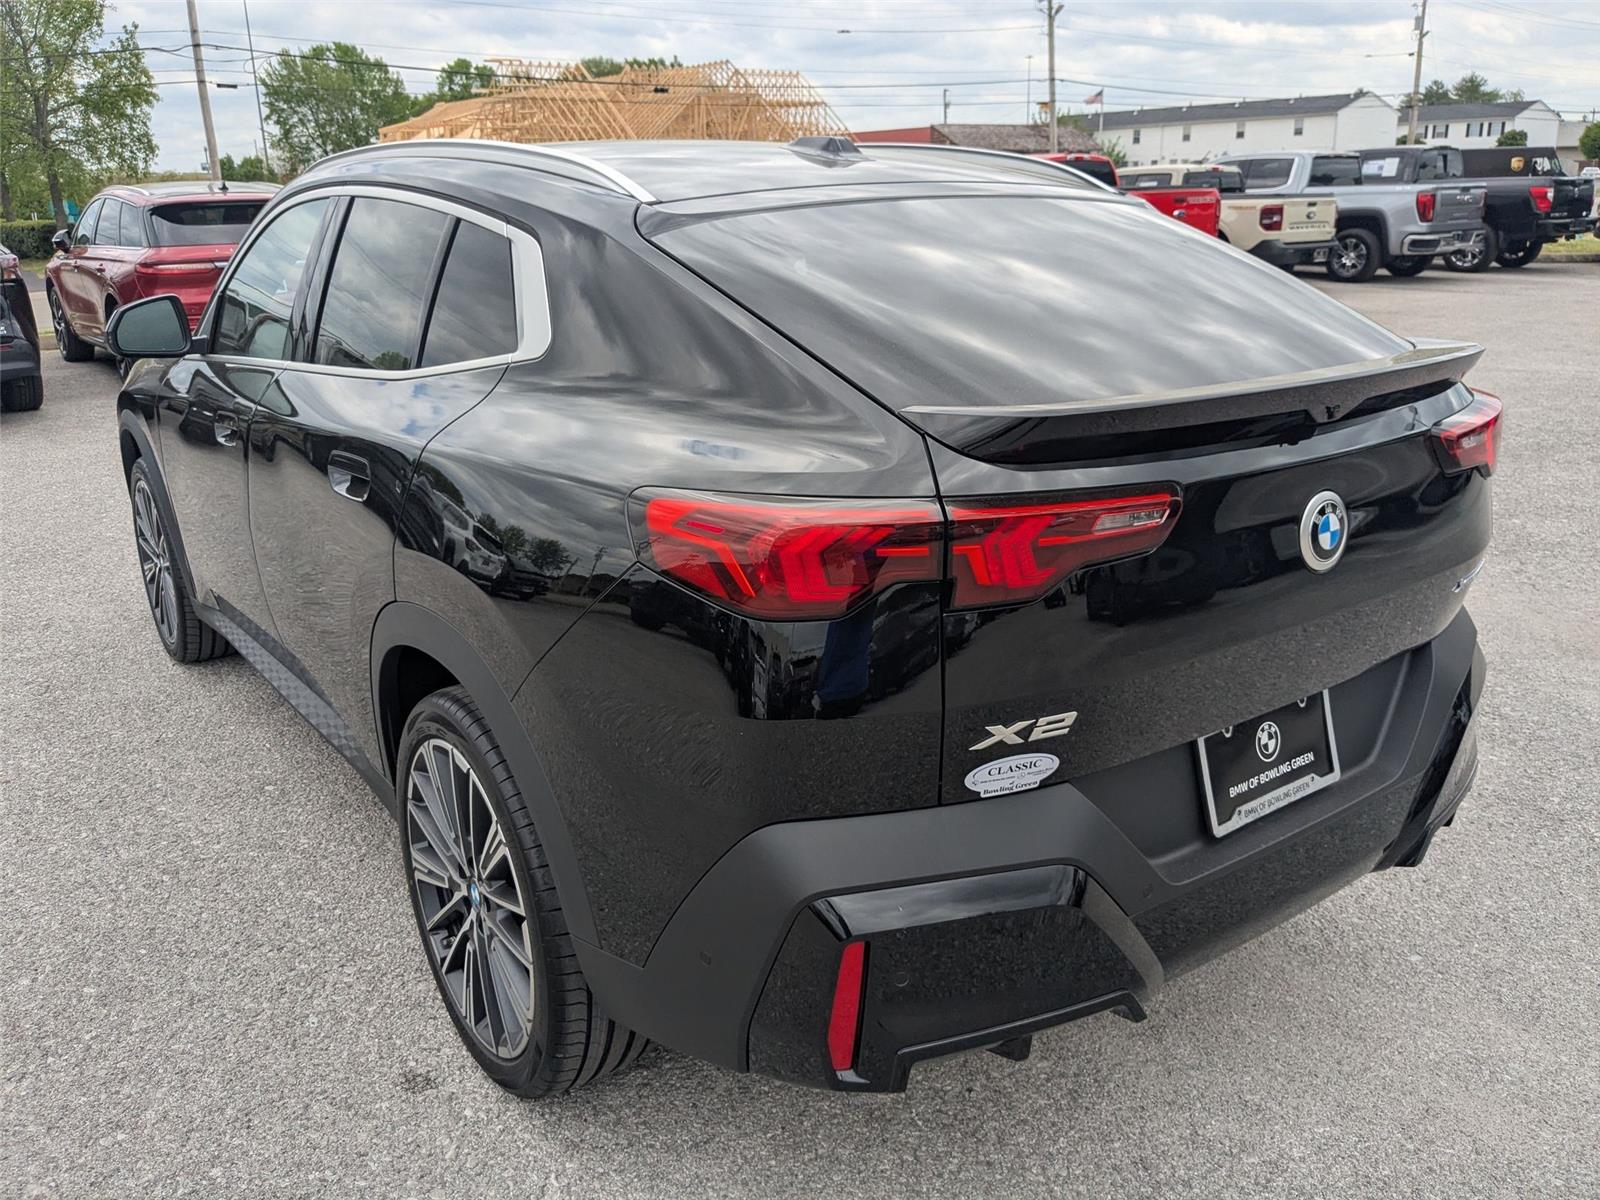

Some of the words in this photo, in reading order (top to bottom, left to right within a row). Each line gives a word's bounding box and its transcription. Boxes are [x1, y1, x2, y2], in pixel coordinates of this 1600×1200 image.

[968, 711, 1078, 751] X2
[988, 759, 1042, 776] CLASSIC
[1229, 781, 1248, 798] BMW
[1248, 776, 1259, 789] OF
[1259, 761, 1291, 784] BOWLING
[1291, 751, 1314, 770] GREEN
[983, 785, 1014, 796] Bowling
[1015, 780, 1038, 790] Green
[1244, 805, 1258, 818] BMW
[1258, 801, 1266, 811] OF
[1267, 789, 1292, 808] BOWLING
[1292, 782, 1310, 796] GREEN
